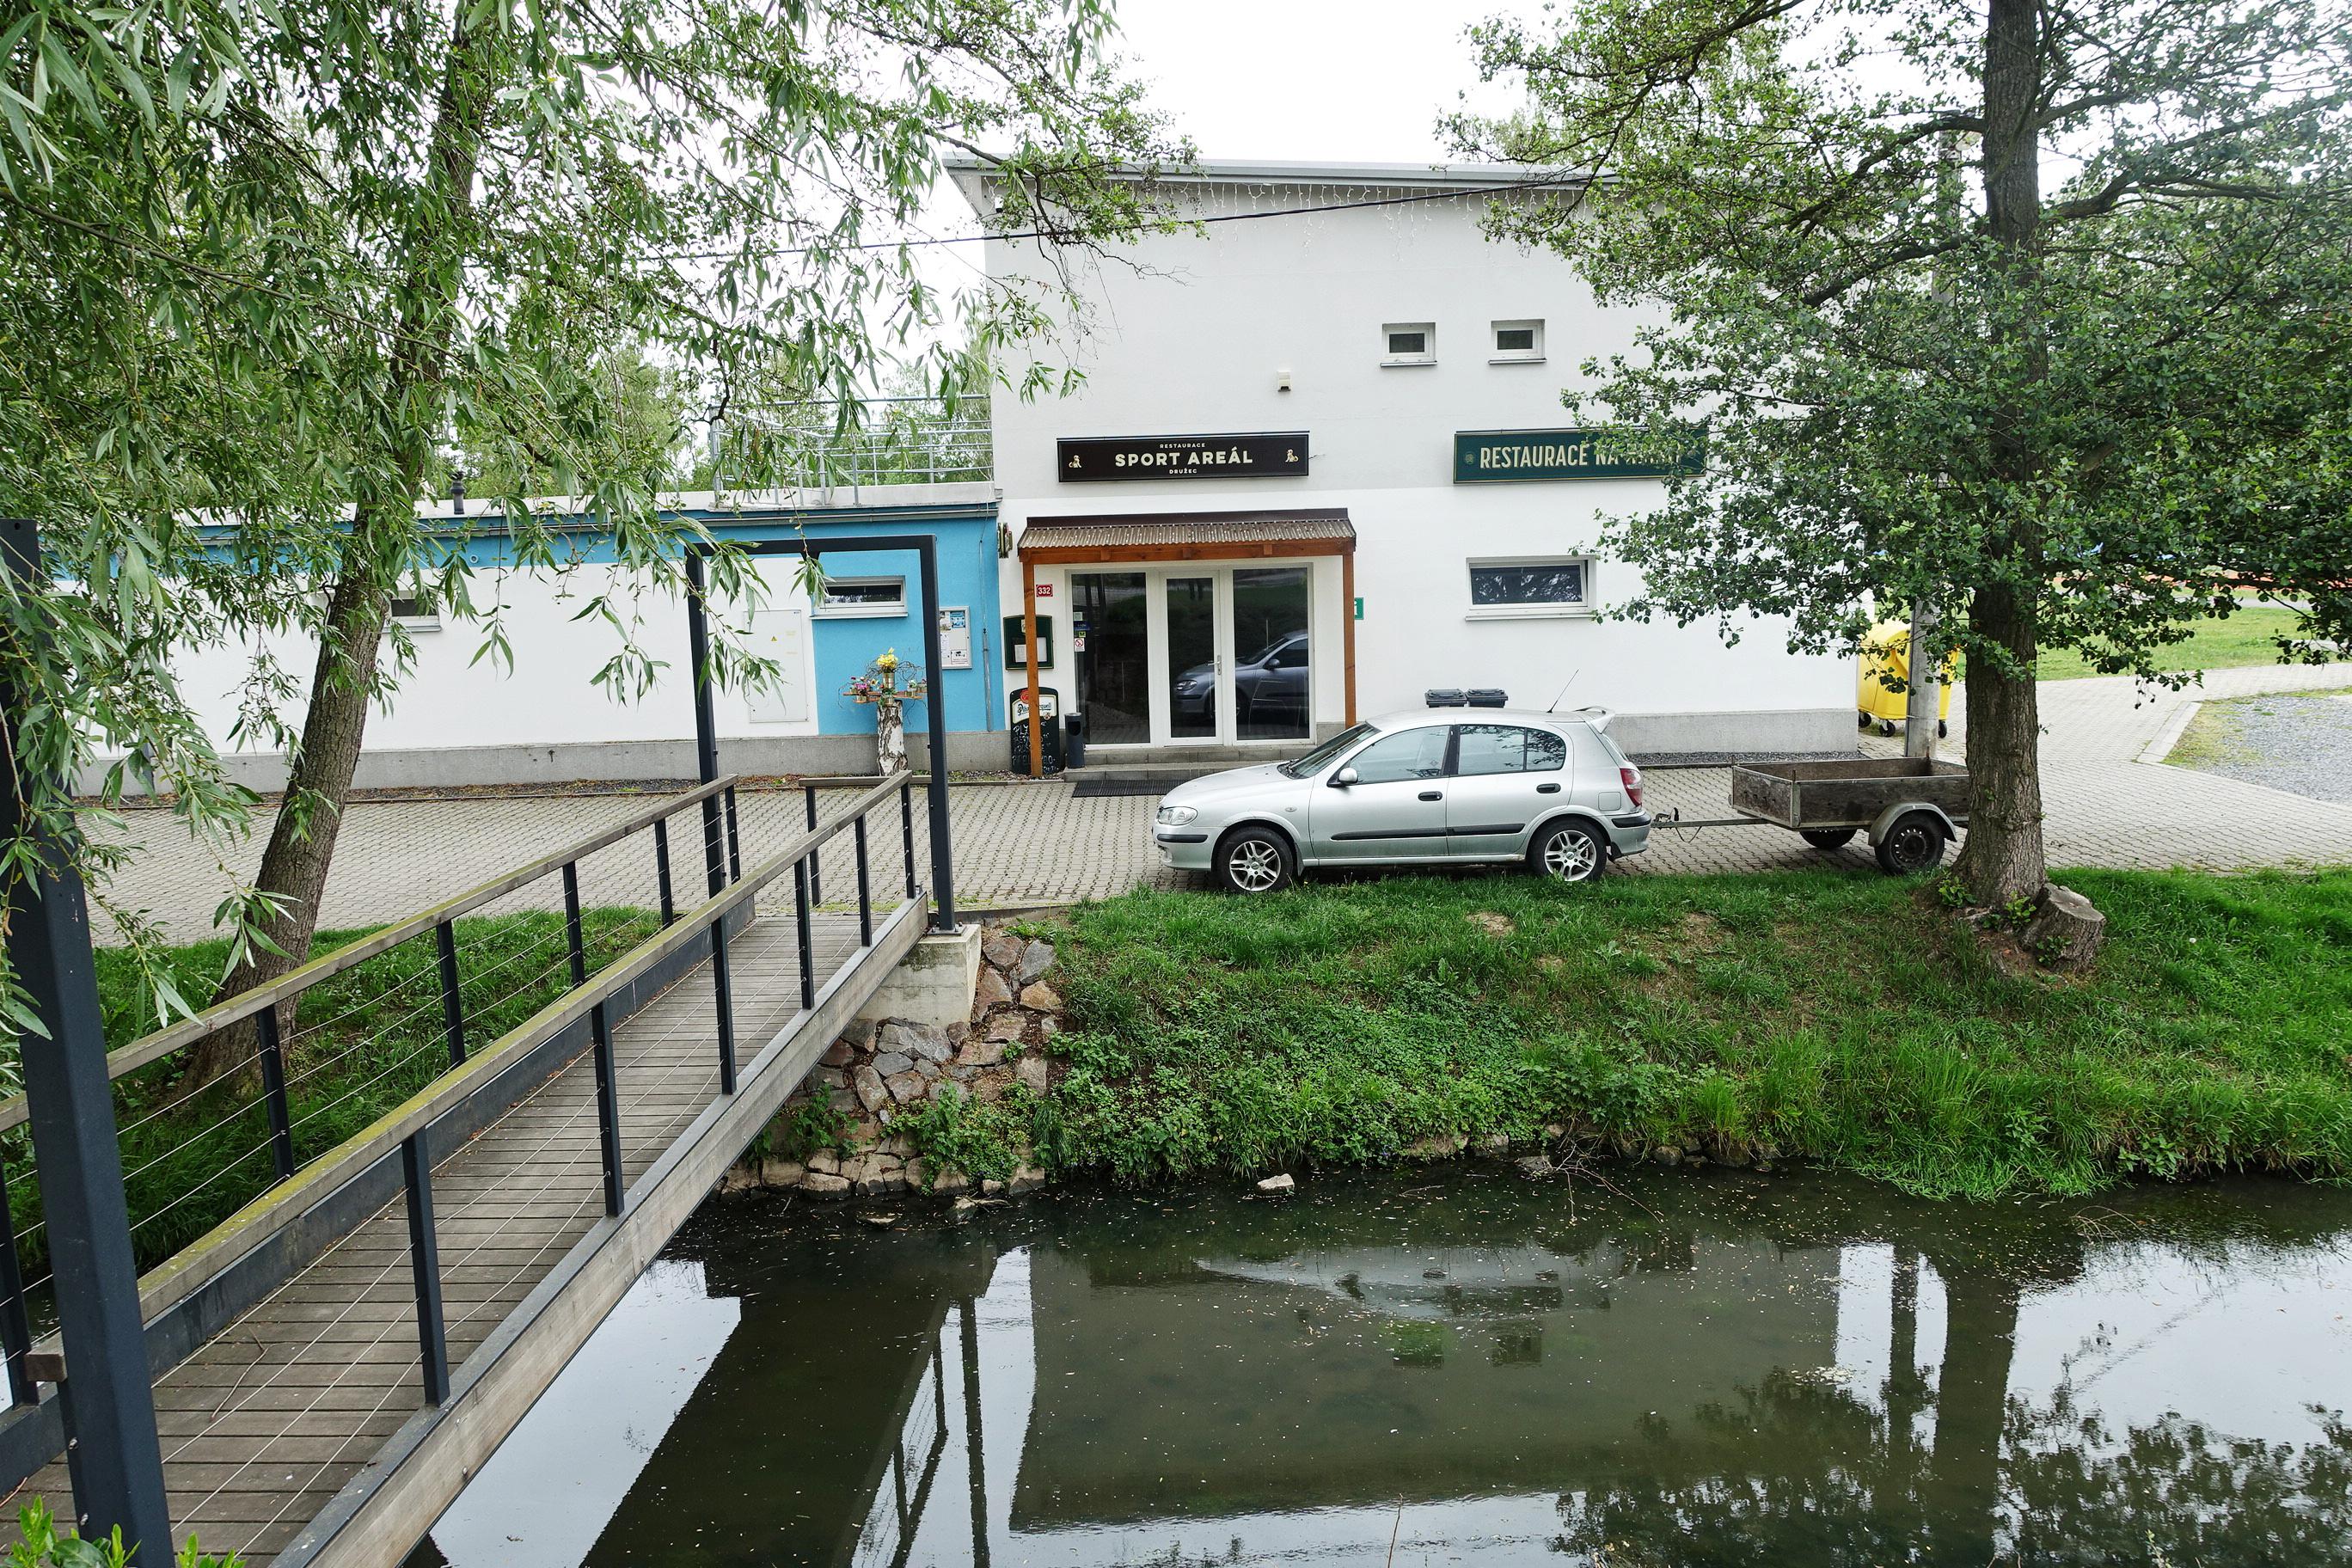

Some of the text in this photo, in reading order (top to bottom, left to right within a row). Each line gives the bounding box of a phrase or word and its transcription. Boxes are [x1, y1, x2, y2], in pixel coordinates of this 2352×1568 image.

[1115, 446, 1253, 467] SPORT AREÁL
[1479, 444, 1588, 469] RESTAURACE
